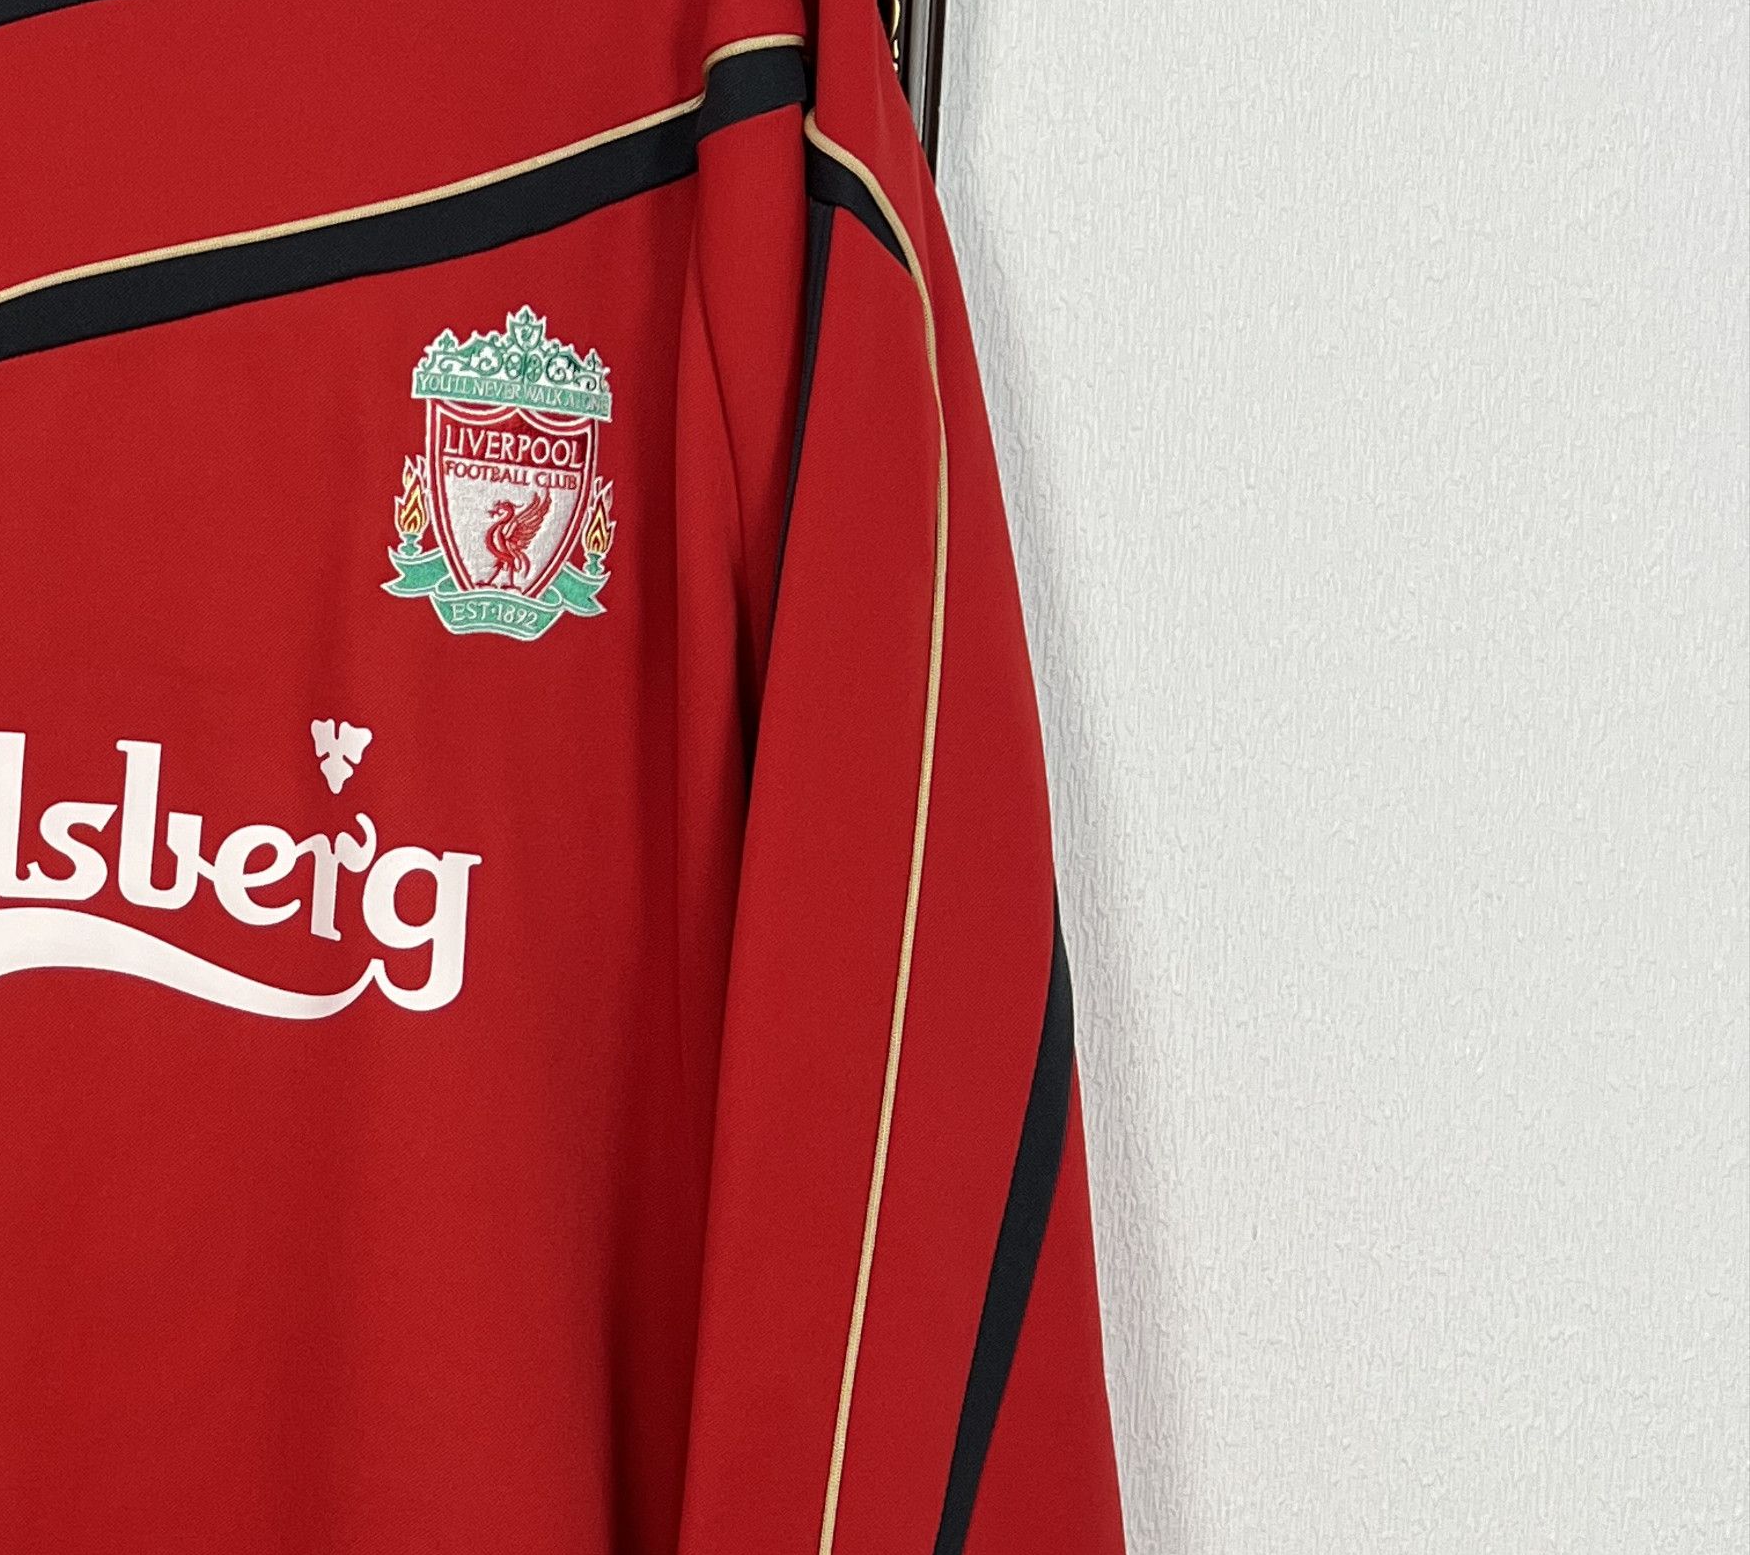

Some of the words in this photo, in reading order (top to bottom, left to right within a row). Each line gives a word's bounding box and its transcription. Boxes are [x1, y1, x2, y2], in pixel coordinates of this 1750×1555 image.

[472, 380, 521, 401] NEVER
[526, 387, 562, 407] WALK
[564, 392, 608, 414] AON
[443, 424, 584, 468] LIVERPOOL
[444, 460, 531, 487] FOOTBALL
[535, 472, 579, 491] CLUB
